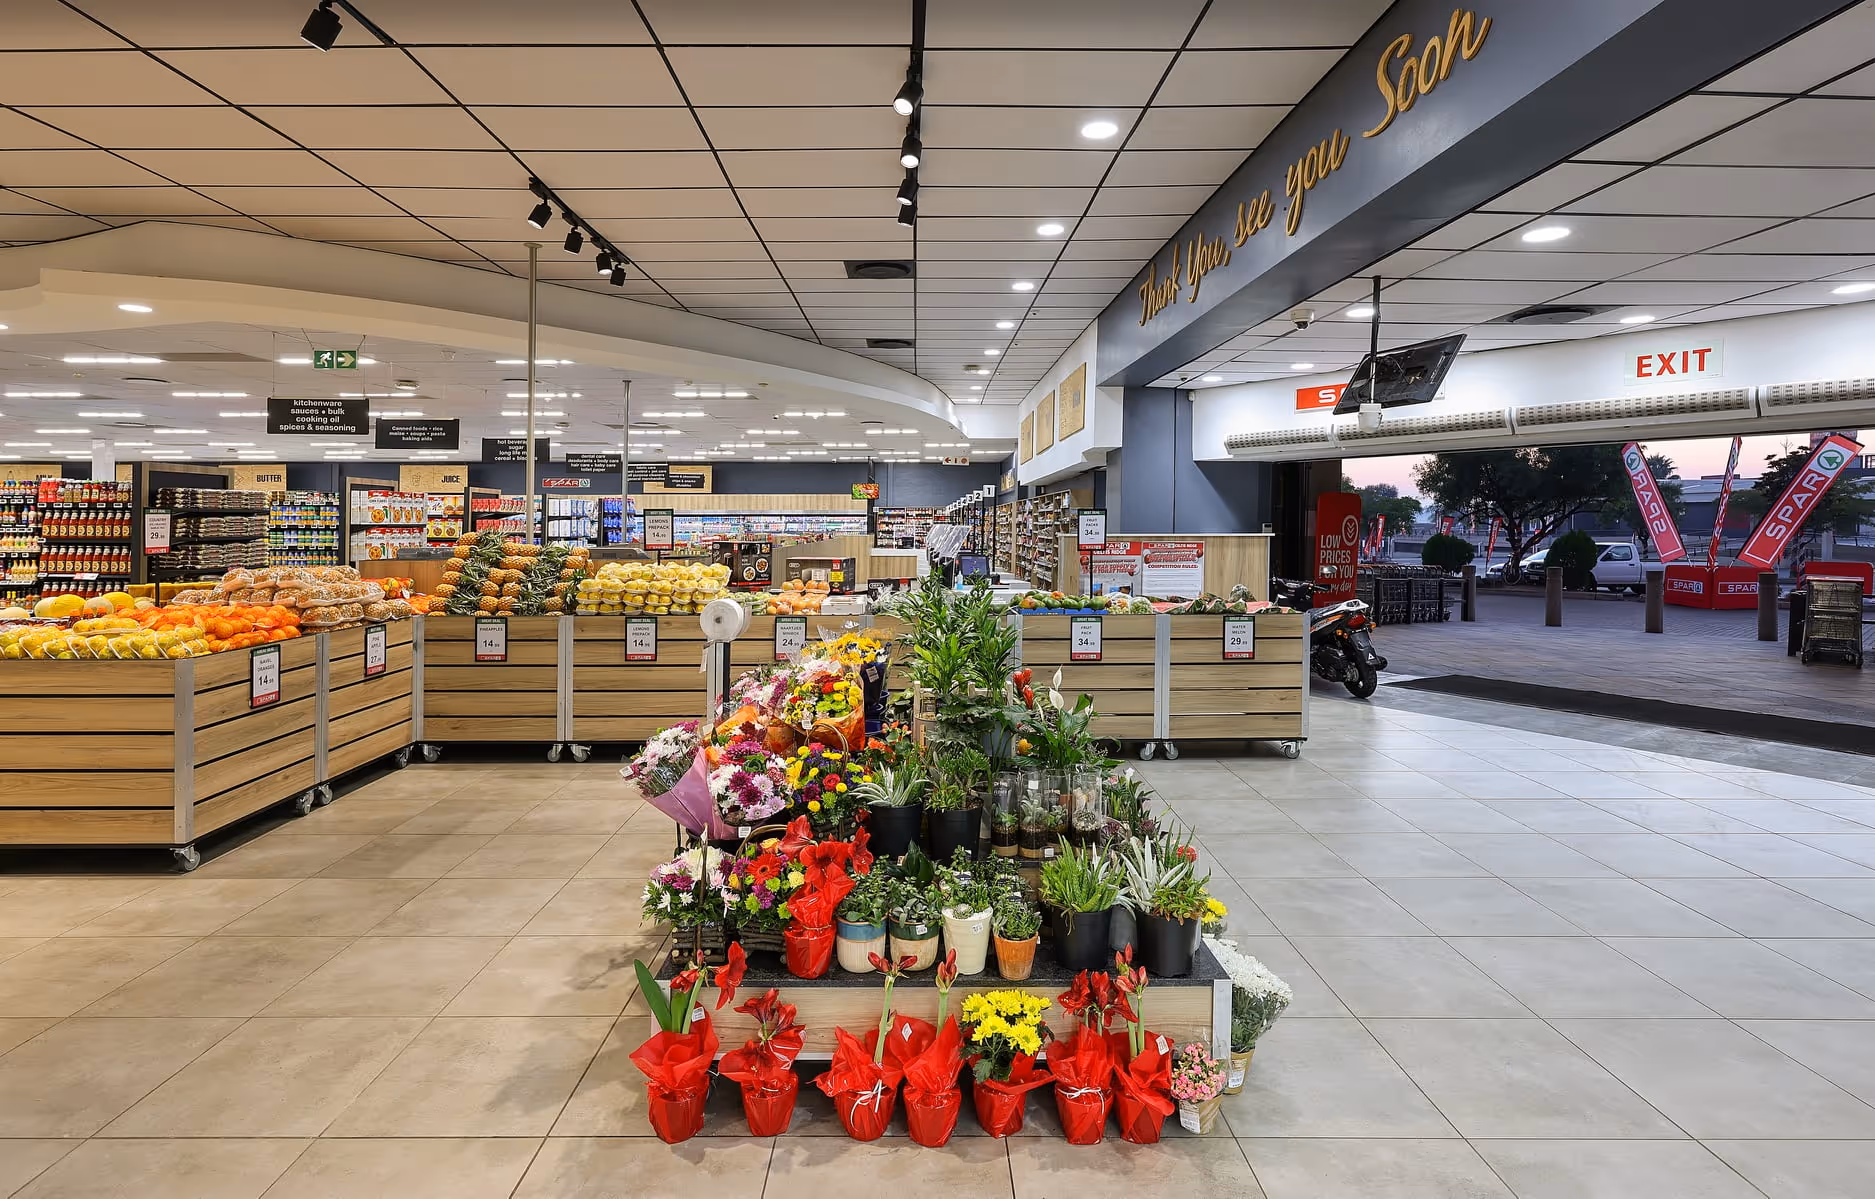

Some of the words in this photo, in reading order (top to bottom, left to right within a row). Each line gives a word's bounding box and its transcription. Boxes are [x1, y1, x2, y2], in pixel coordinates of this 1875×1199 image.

[1138, 242, 1182, 327] Thank
[1233, 189, 1276, 249] see
[1285, 128, 1351, 237] you
[1362, 8, 1493, 138] Soon
[1636, 348, 1712, 378] EXIT
[296, 416, 328, 424] cooking
[280, 424, 305, 432] spices
[315, 424, 356, 433] seasoning
[256, 474, 282, 483] BUTTER
[441, 475, 460, 483] JUICE
[1765, 472, 1824, 540] SPAR
[1320, 534, 1341, 549] LOW
[1320, 550, 1351, 564] PRICES
[1339, 565, 1354, 578] YOU
[1673, 581, 1695, 591] SPAR
[1728, 584, 1757, 592] SPAR
